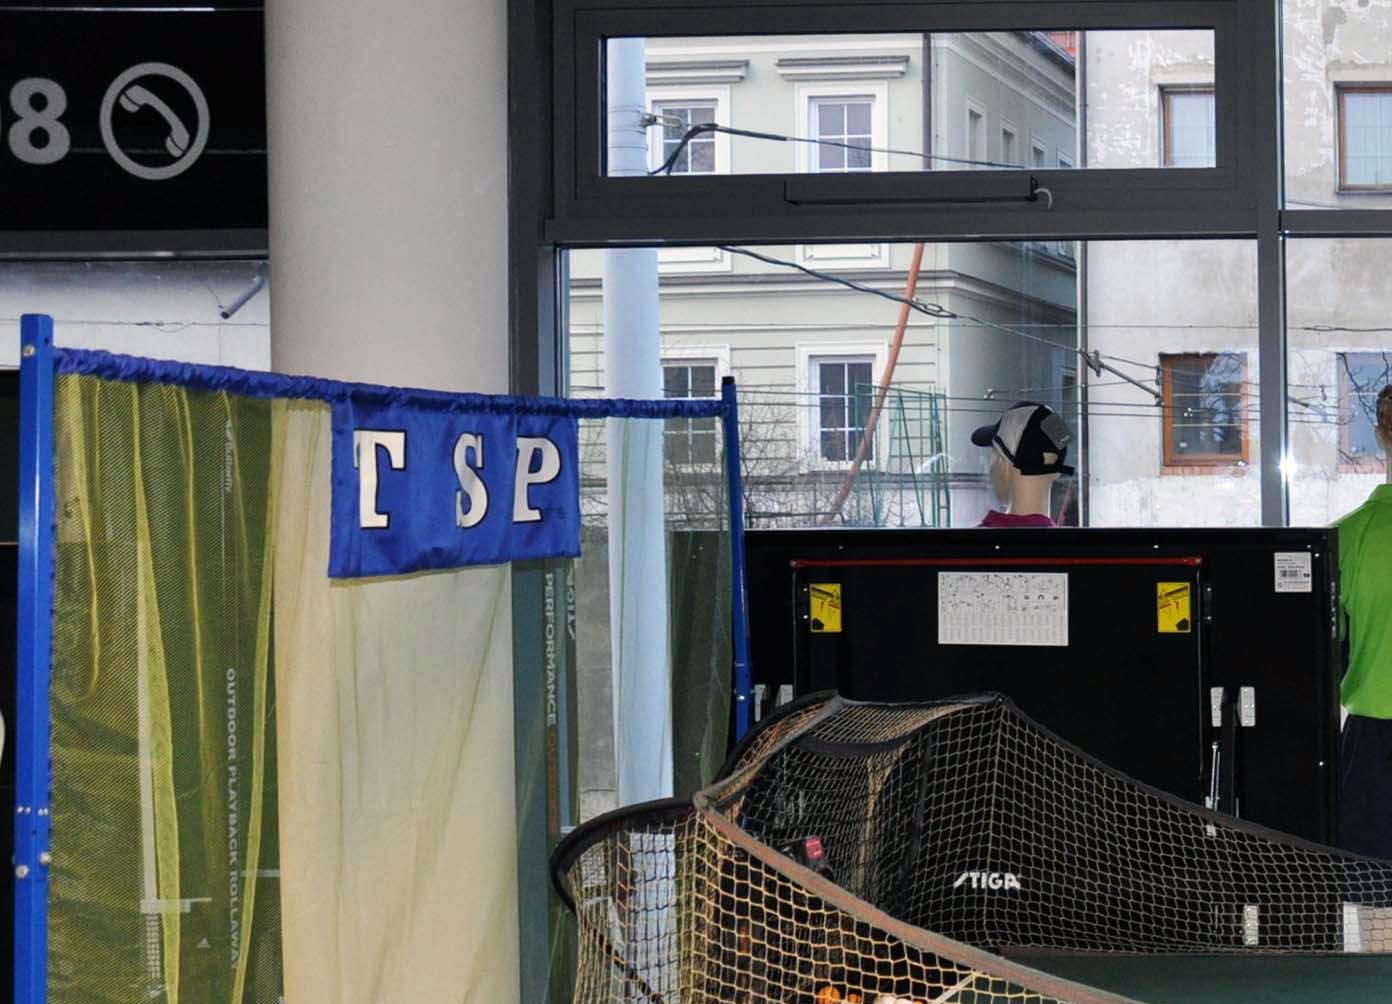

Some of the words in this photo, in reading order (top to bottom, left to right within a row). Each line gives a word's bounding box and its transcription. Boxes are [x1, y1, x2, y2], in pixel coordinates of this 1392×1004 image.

[8, 77, 71, 165] 8
[544, 572, 557, 726] PERFORMANCE
[226, 667, 237, 761] OUTDOOR
[227, 765, 239, 866] PLAYBACK
[953, 871, 1021, 890] STIGA
